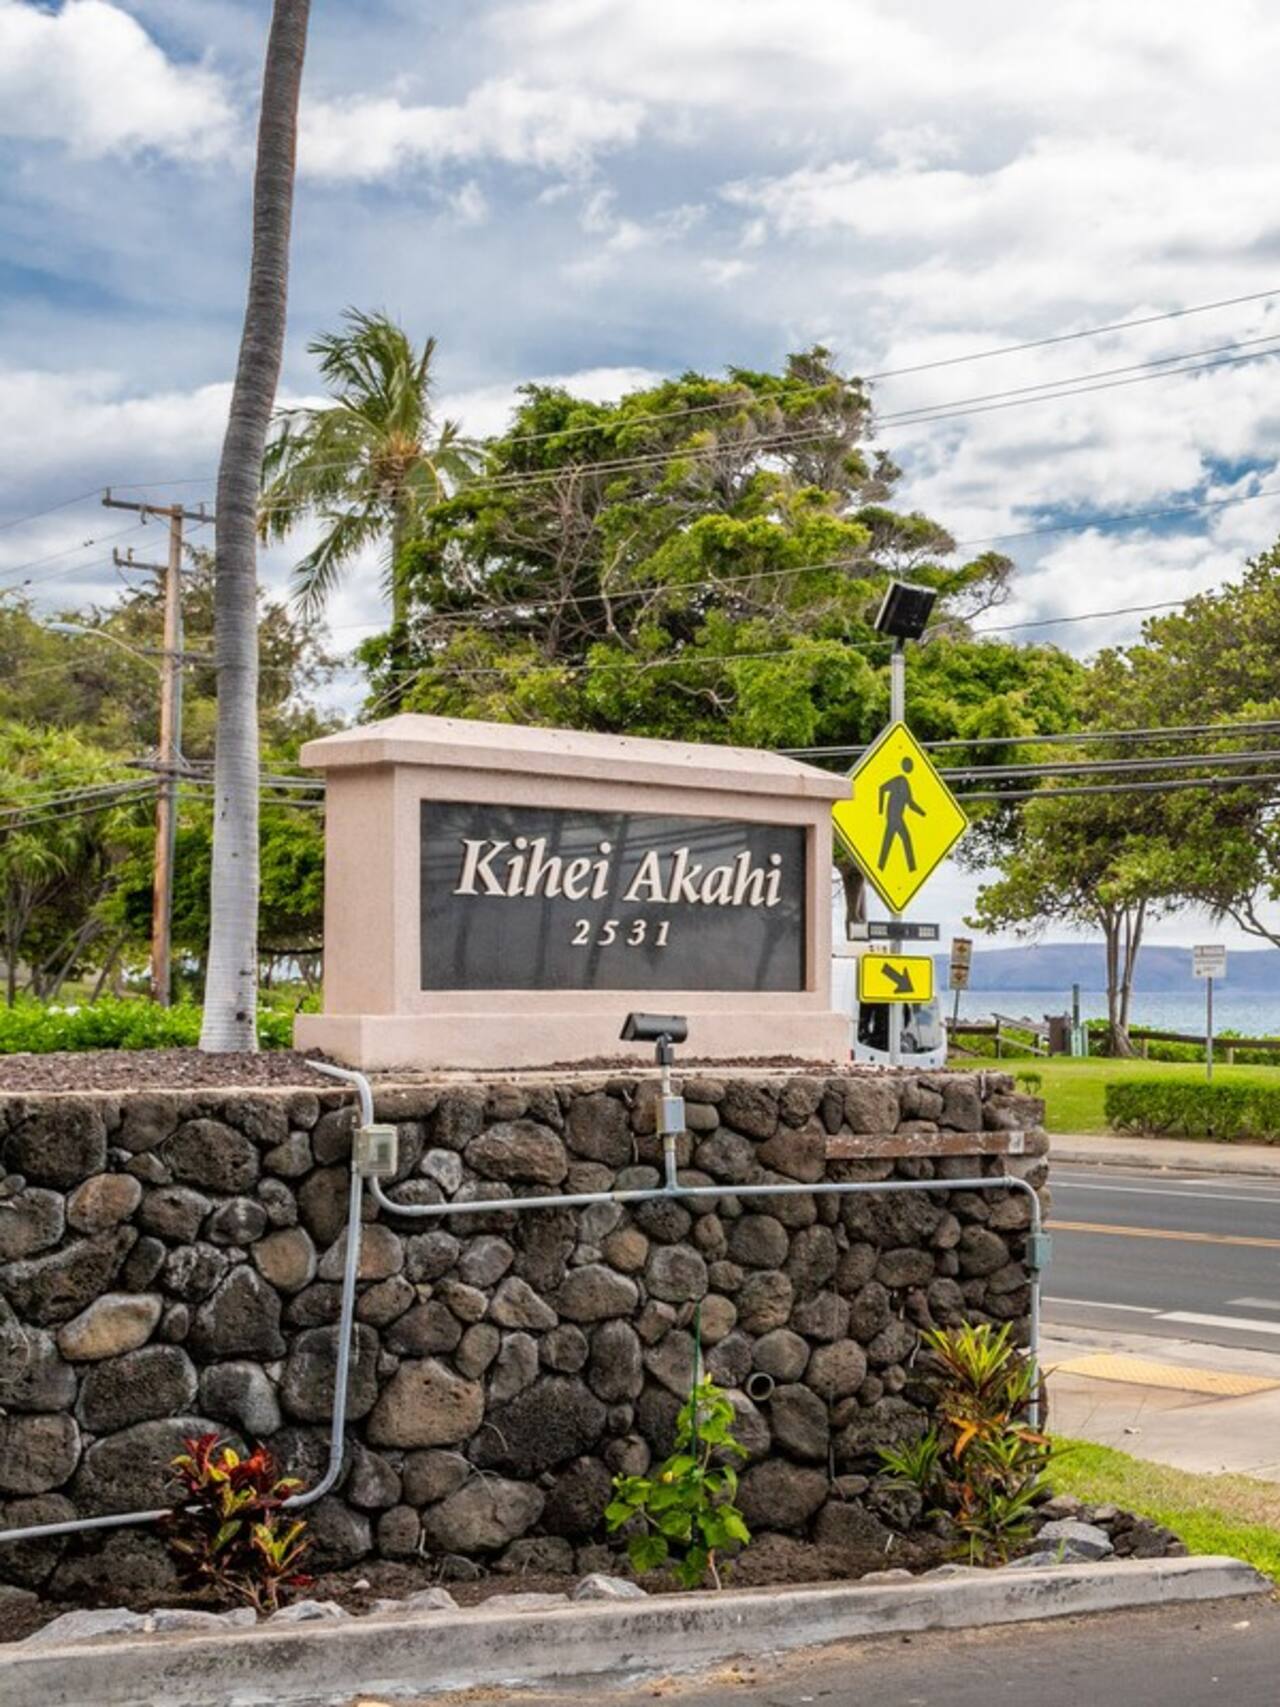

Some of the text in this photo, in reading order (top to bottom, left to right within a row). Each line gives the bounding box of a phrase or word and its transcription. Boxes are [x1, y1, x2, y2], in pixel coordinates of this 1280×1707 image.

[453, 836, 782, 908] Kihei Akahi
[571, 918, 669, 947] 2531
